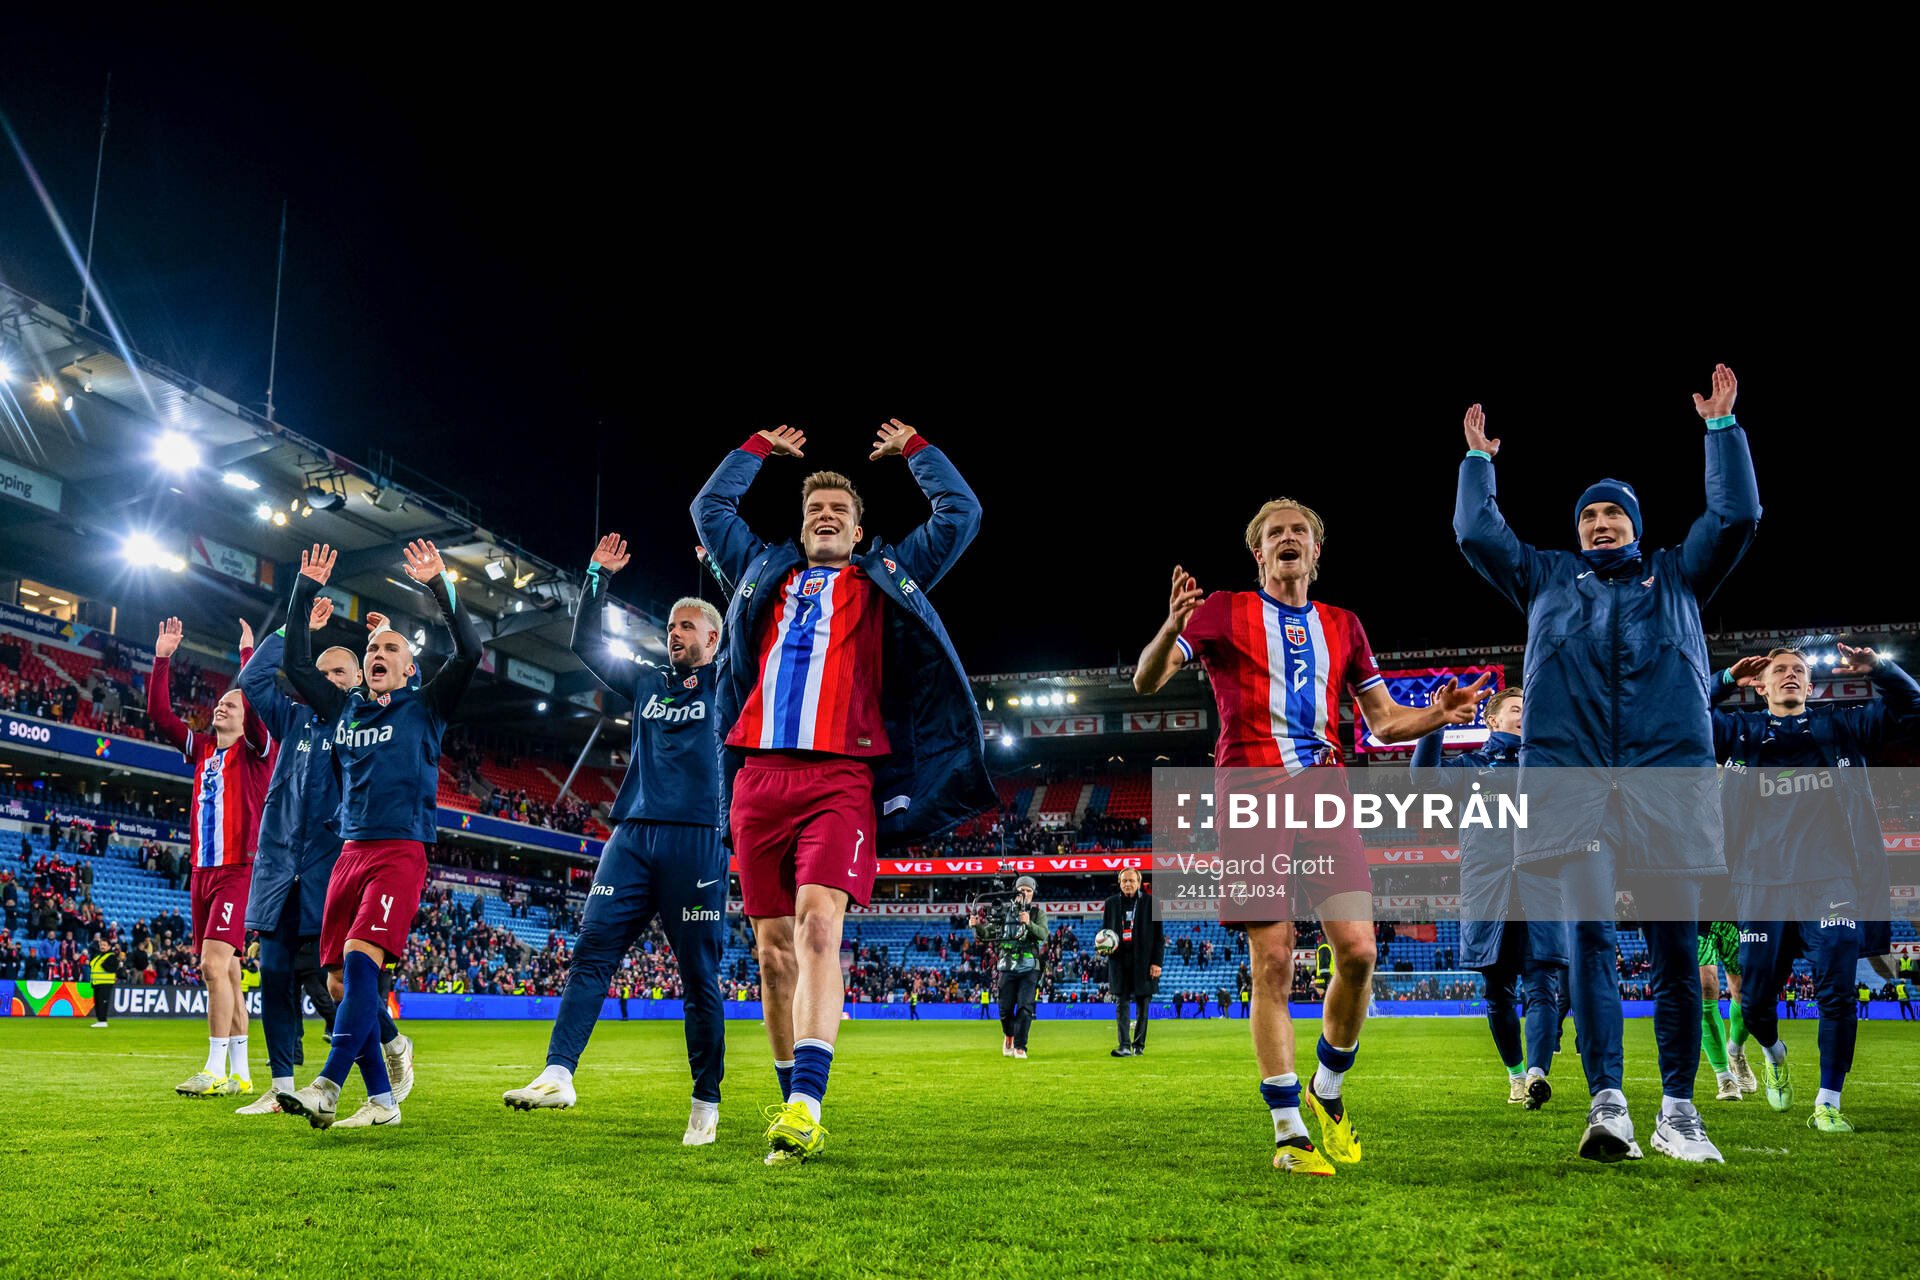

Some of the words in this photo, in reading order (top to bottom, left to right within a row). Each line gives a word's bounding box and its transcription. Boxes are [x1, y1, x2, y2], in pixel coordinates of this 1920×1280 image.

[802, 600, 815, 626] 7
[1401, 651, 1425, 659] VG
[1434, 649, 1459, 657] VG
[1467, 647, 1491, 656] VG
[1500, 645, 1524, 653] VG
[1000, 673, 1021, 681] VG
[1294, 659, 1308, 693] 2
[641, 694, 705, 722] bama
[1032, 719, 1095, 736] VG
[1132, 713, 1199, 731] VG
[9, 721, 51, 743] 90:00
[336, 720, 393, 748] bama
[1759, 770, 1834, 797] bama
[119, 822, 136, 832] Norsk
[136, 824, 157, 837] Tipping
[853, 829, 864, 863] 7
[1882, 837, 1920, 849] VG
[1383, 851, 1424, 861] VG
[1441, 849, 1460, 860] V
[894, 861, 933, 873] VG
[945, 861, 983, 872] VG
[997, 859, 1035, 871] VG
[1049, 859, 1088, 870] VG
[1102, 857, 1142, 868] VG
[728, 902, 744, 912] V
[888, 904, 923, 914] VG
[927, 904, 959, 914] VG
[1047, 903, 1080, 912] VG
[1088, 902, 1104, 911] V
[1173, 900, 1206, 910] VG
[222, 902, 234, 925] 9
[682, 907, 720, 922] bama
[1820, 916, 1856, 929] bama
[113, 988, 170, 1013] UEFA
[175, 988, 262, 1014] NATNS
